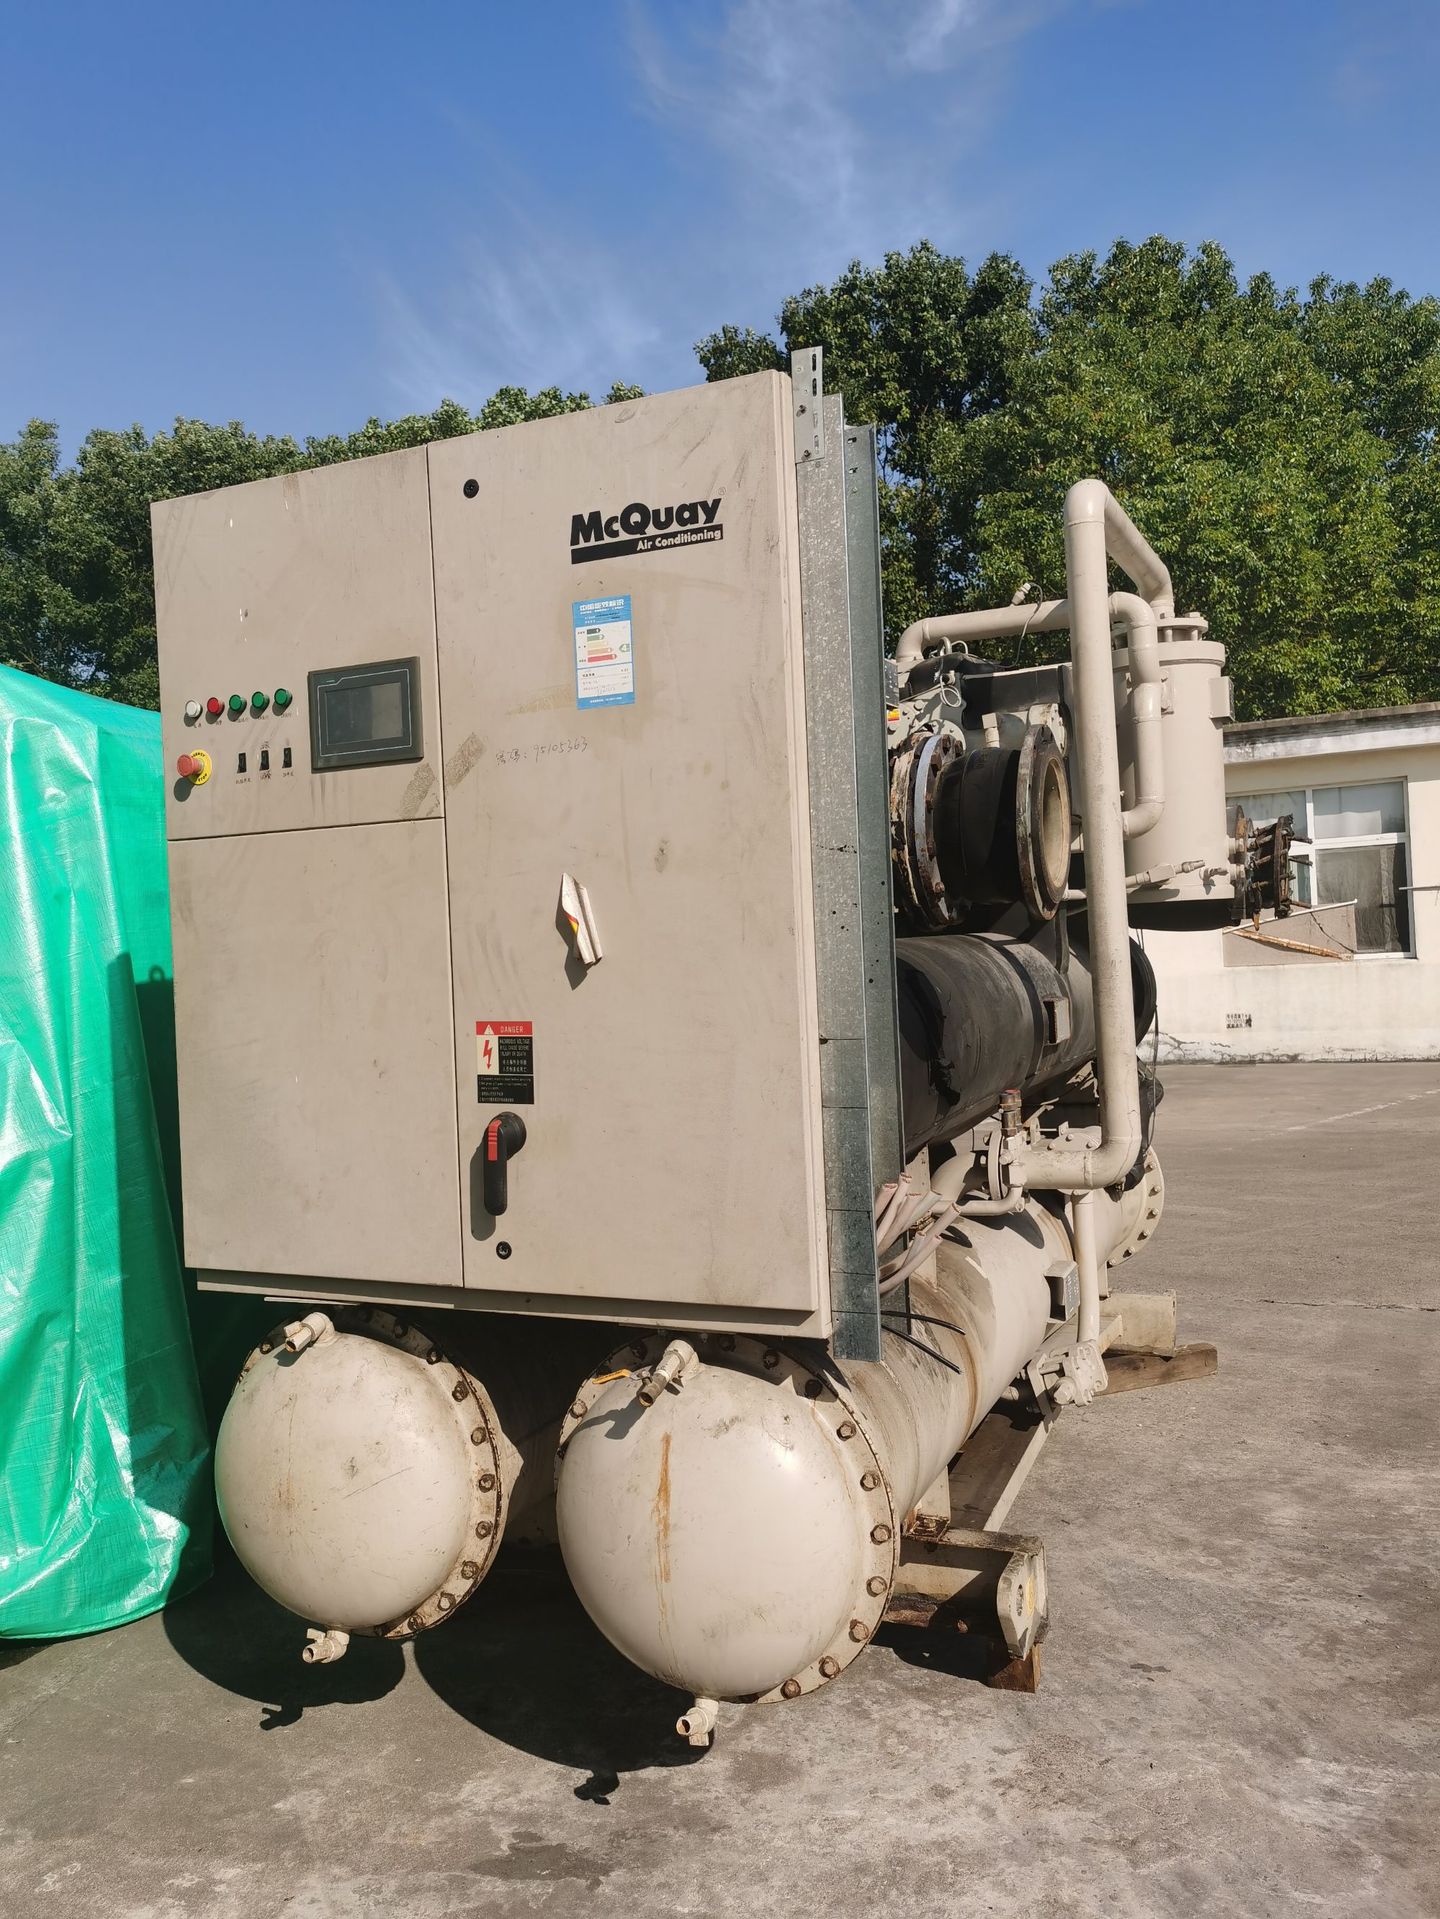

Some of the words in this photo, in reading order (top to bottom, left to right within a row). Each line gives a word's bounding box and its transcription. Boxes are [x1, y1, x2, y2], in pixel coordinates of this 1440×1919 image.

[570, 498, 721, 546] McQuay
[637, 540, 652, 551] Air
[655, 529, 722, 547] Conditioning
[500, 1025, 524, 1033] DANGER
